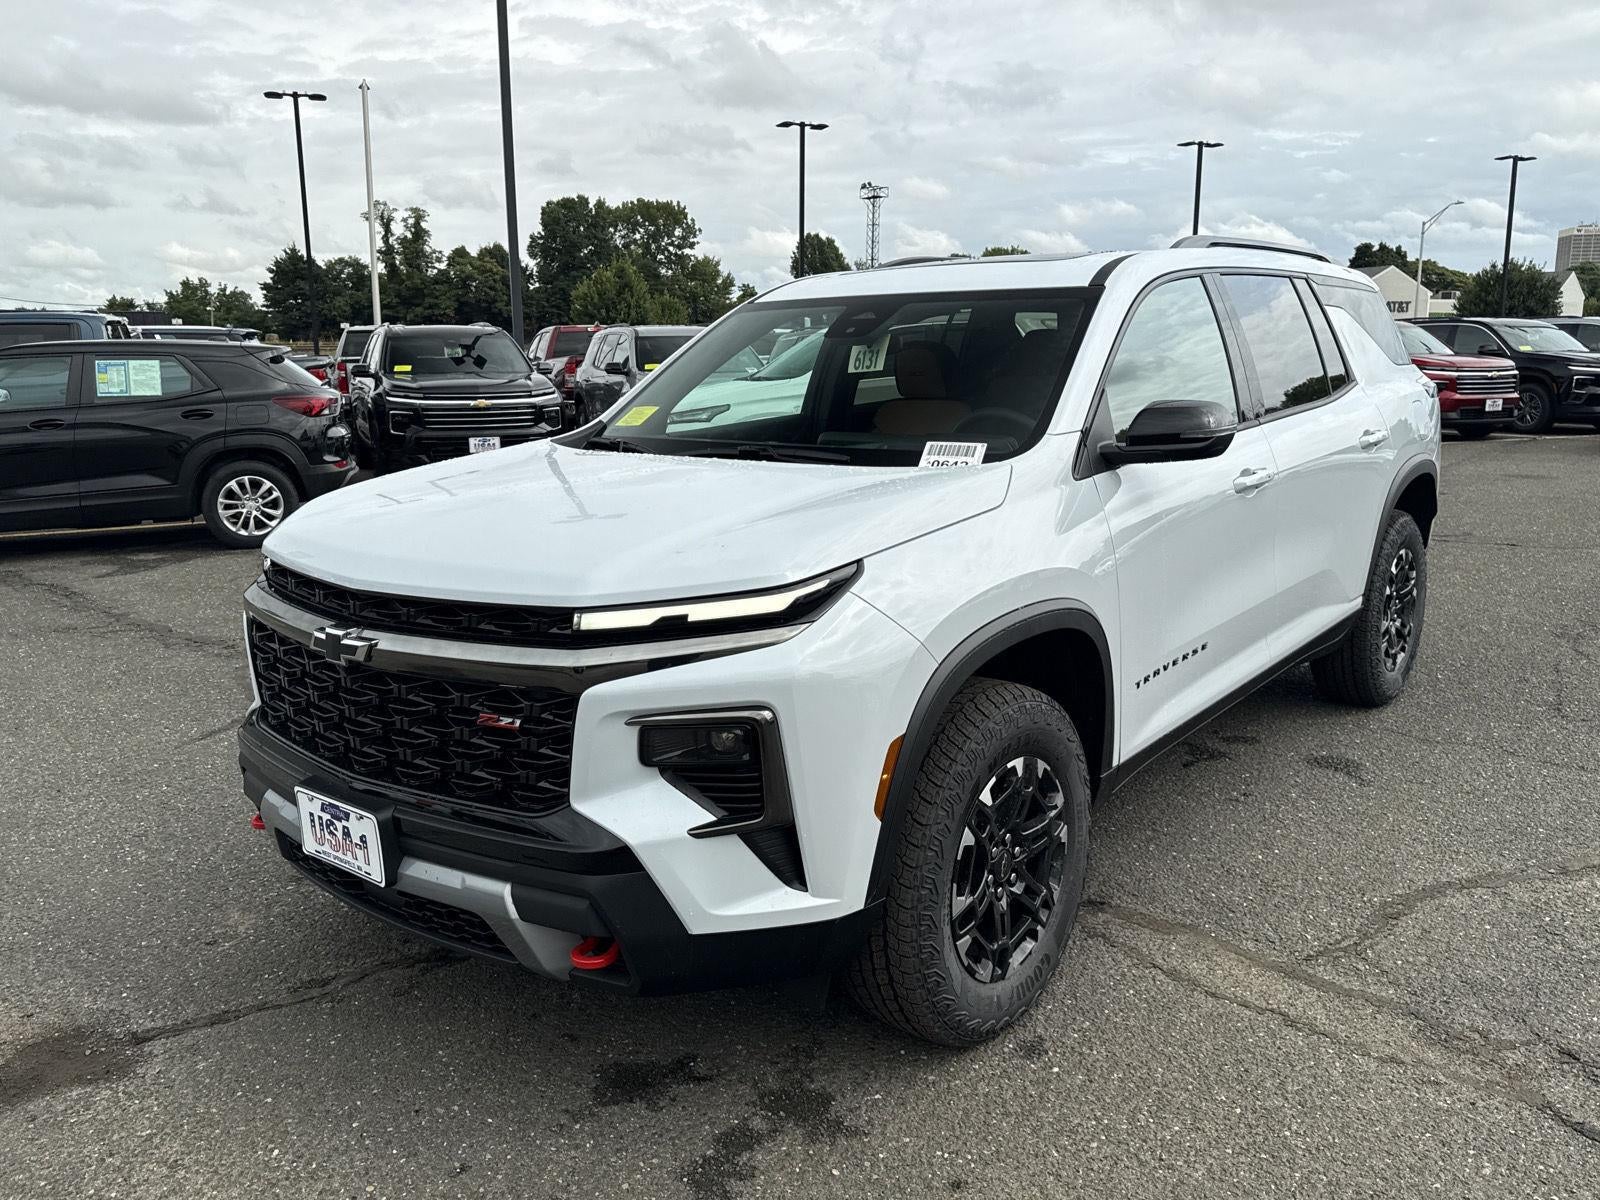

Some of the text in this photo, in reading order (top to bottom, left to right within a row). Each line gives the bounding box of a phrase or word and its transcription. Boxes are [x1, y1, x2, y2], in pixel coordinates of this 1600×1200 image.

[1386, 301, 1411, 312] AT&T
[854, 350, 879, 370] 6131
[1135, 641, 1208, 689] TRAVERSE
[309, 811, 370, 866] USA-1
